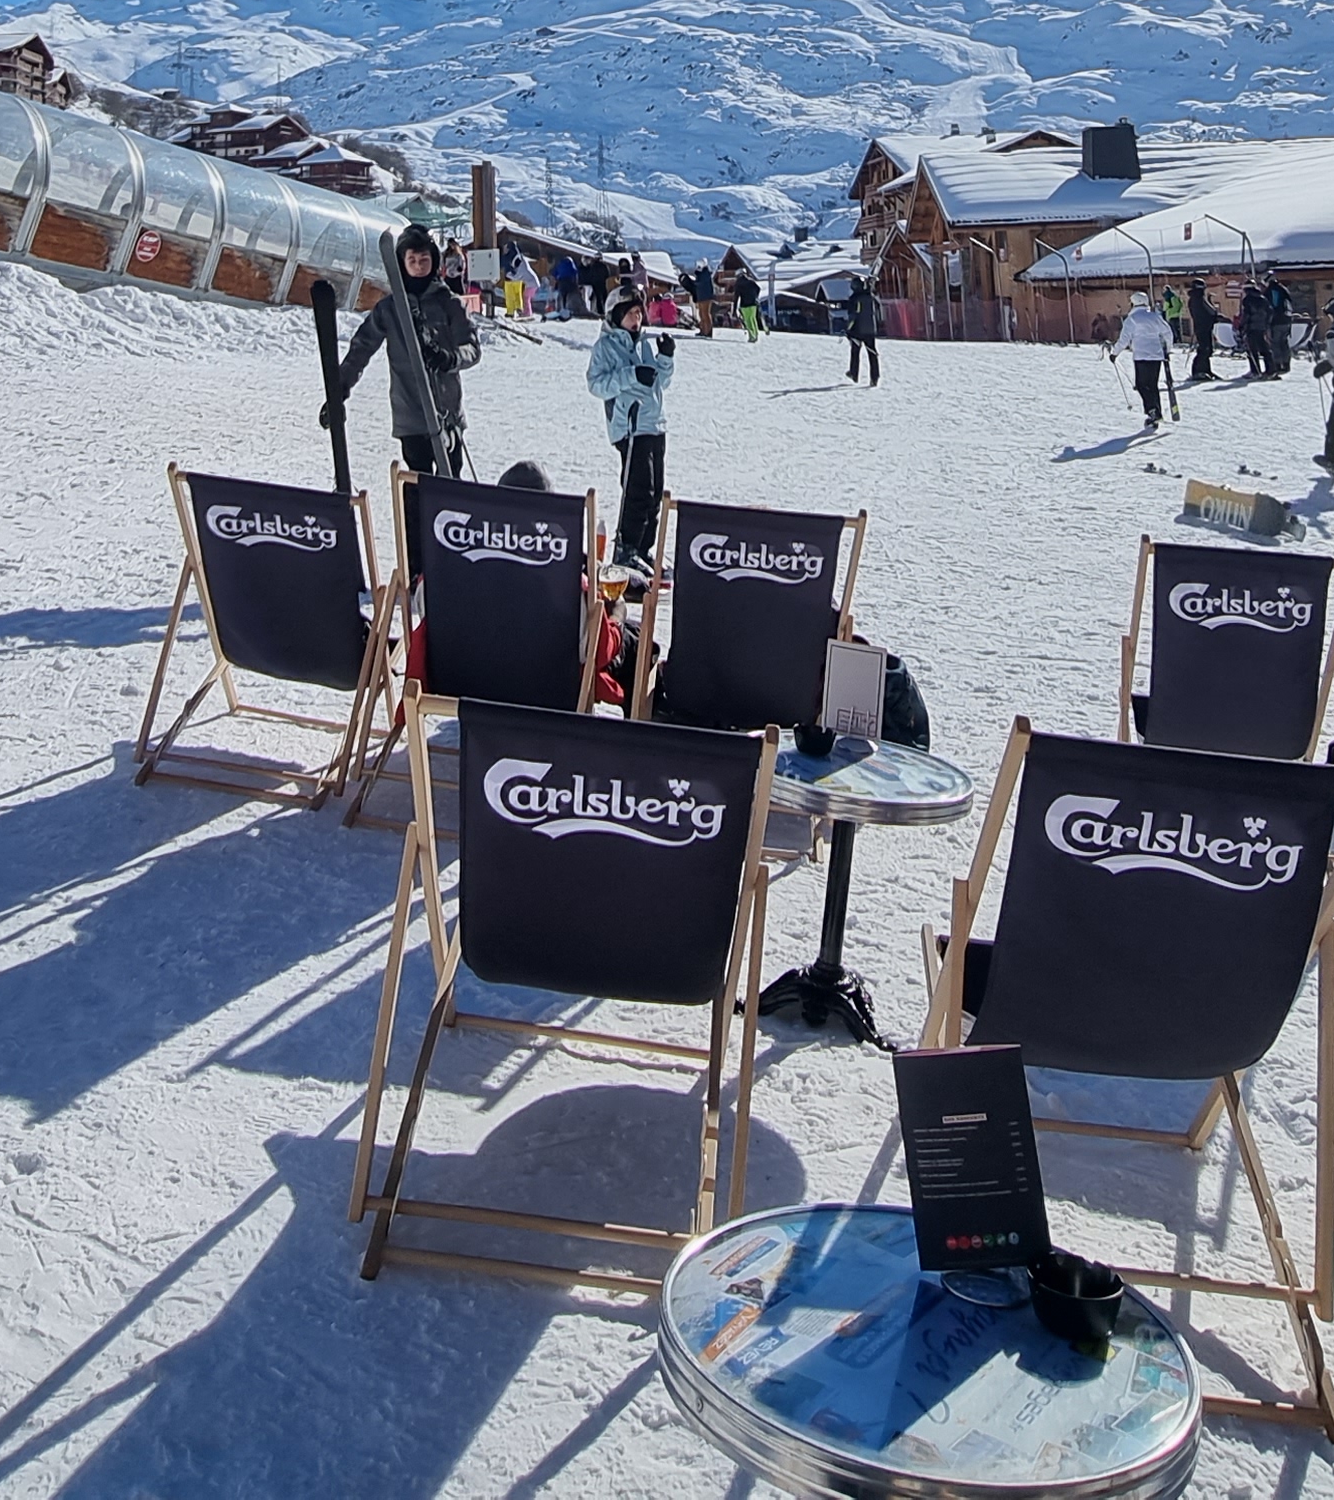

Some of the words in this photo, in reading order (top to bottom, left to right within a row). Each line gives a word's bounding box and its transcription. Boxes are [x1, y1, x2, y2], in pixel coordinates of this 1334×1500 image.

[207, 505, 337, 551] Carlsberg
[434, 510, 569, 563] Carlsberg
[689, 533, 825, 585] Carlsberg
[1169, 583, 1312, 632] Carlsberg
[484, 758, 726, 846] Carlsberg
[1045, 795, 1303, 891] Carlsberg
